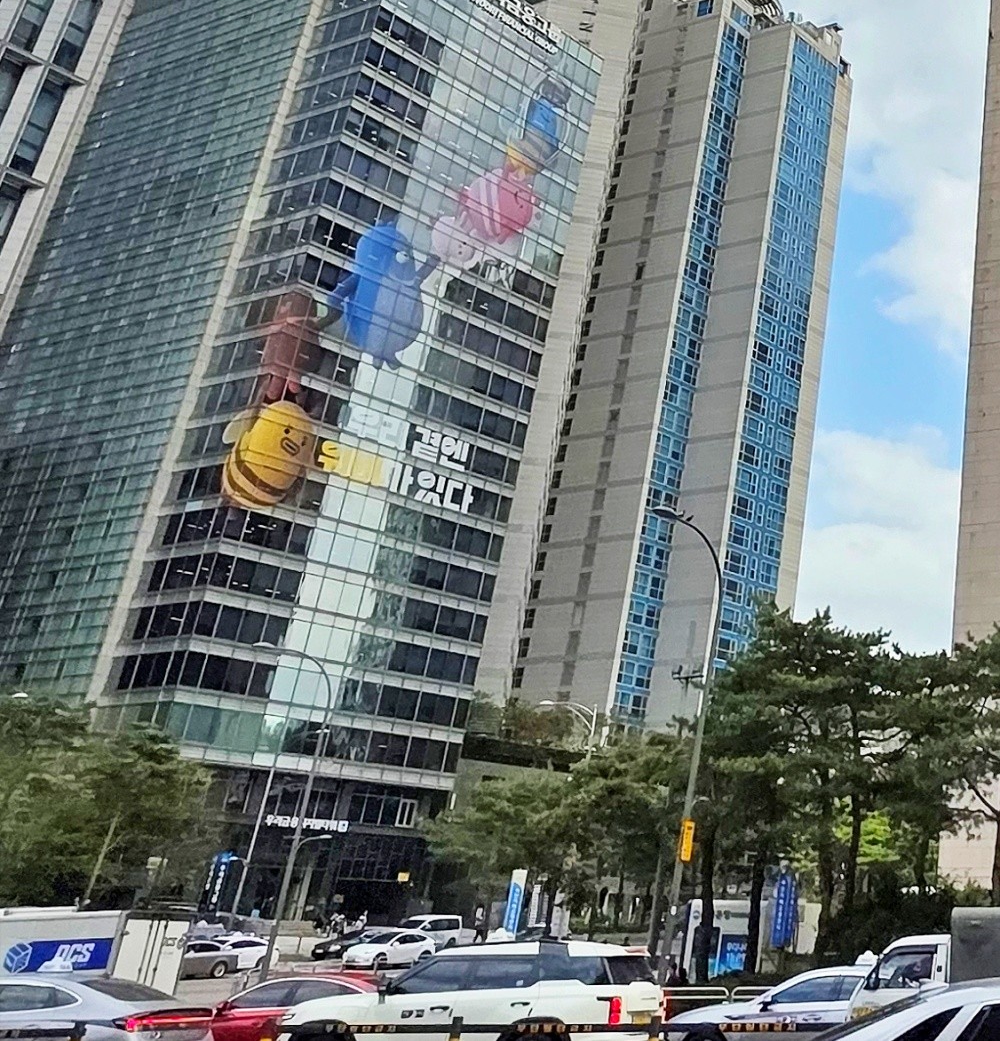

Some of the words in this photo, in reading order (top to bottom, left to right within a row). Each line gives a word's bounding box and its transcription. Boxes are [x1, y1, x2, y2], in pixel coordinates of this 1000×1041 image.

[498, 11, 535, 40] FINANCIAL
[534, 36, 559, 55] GROUP
[414, 470, 475, 513] 있다
